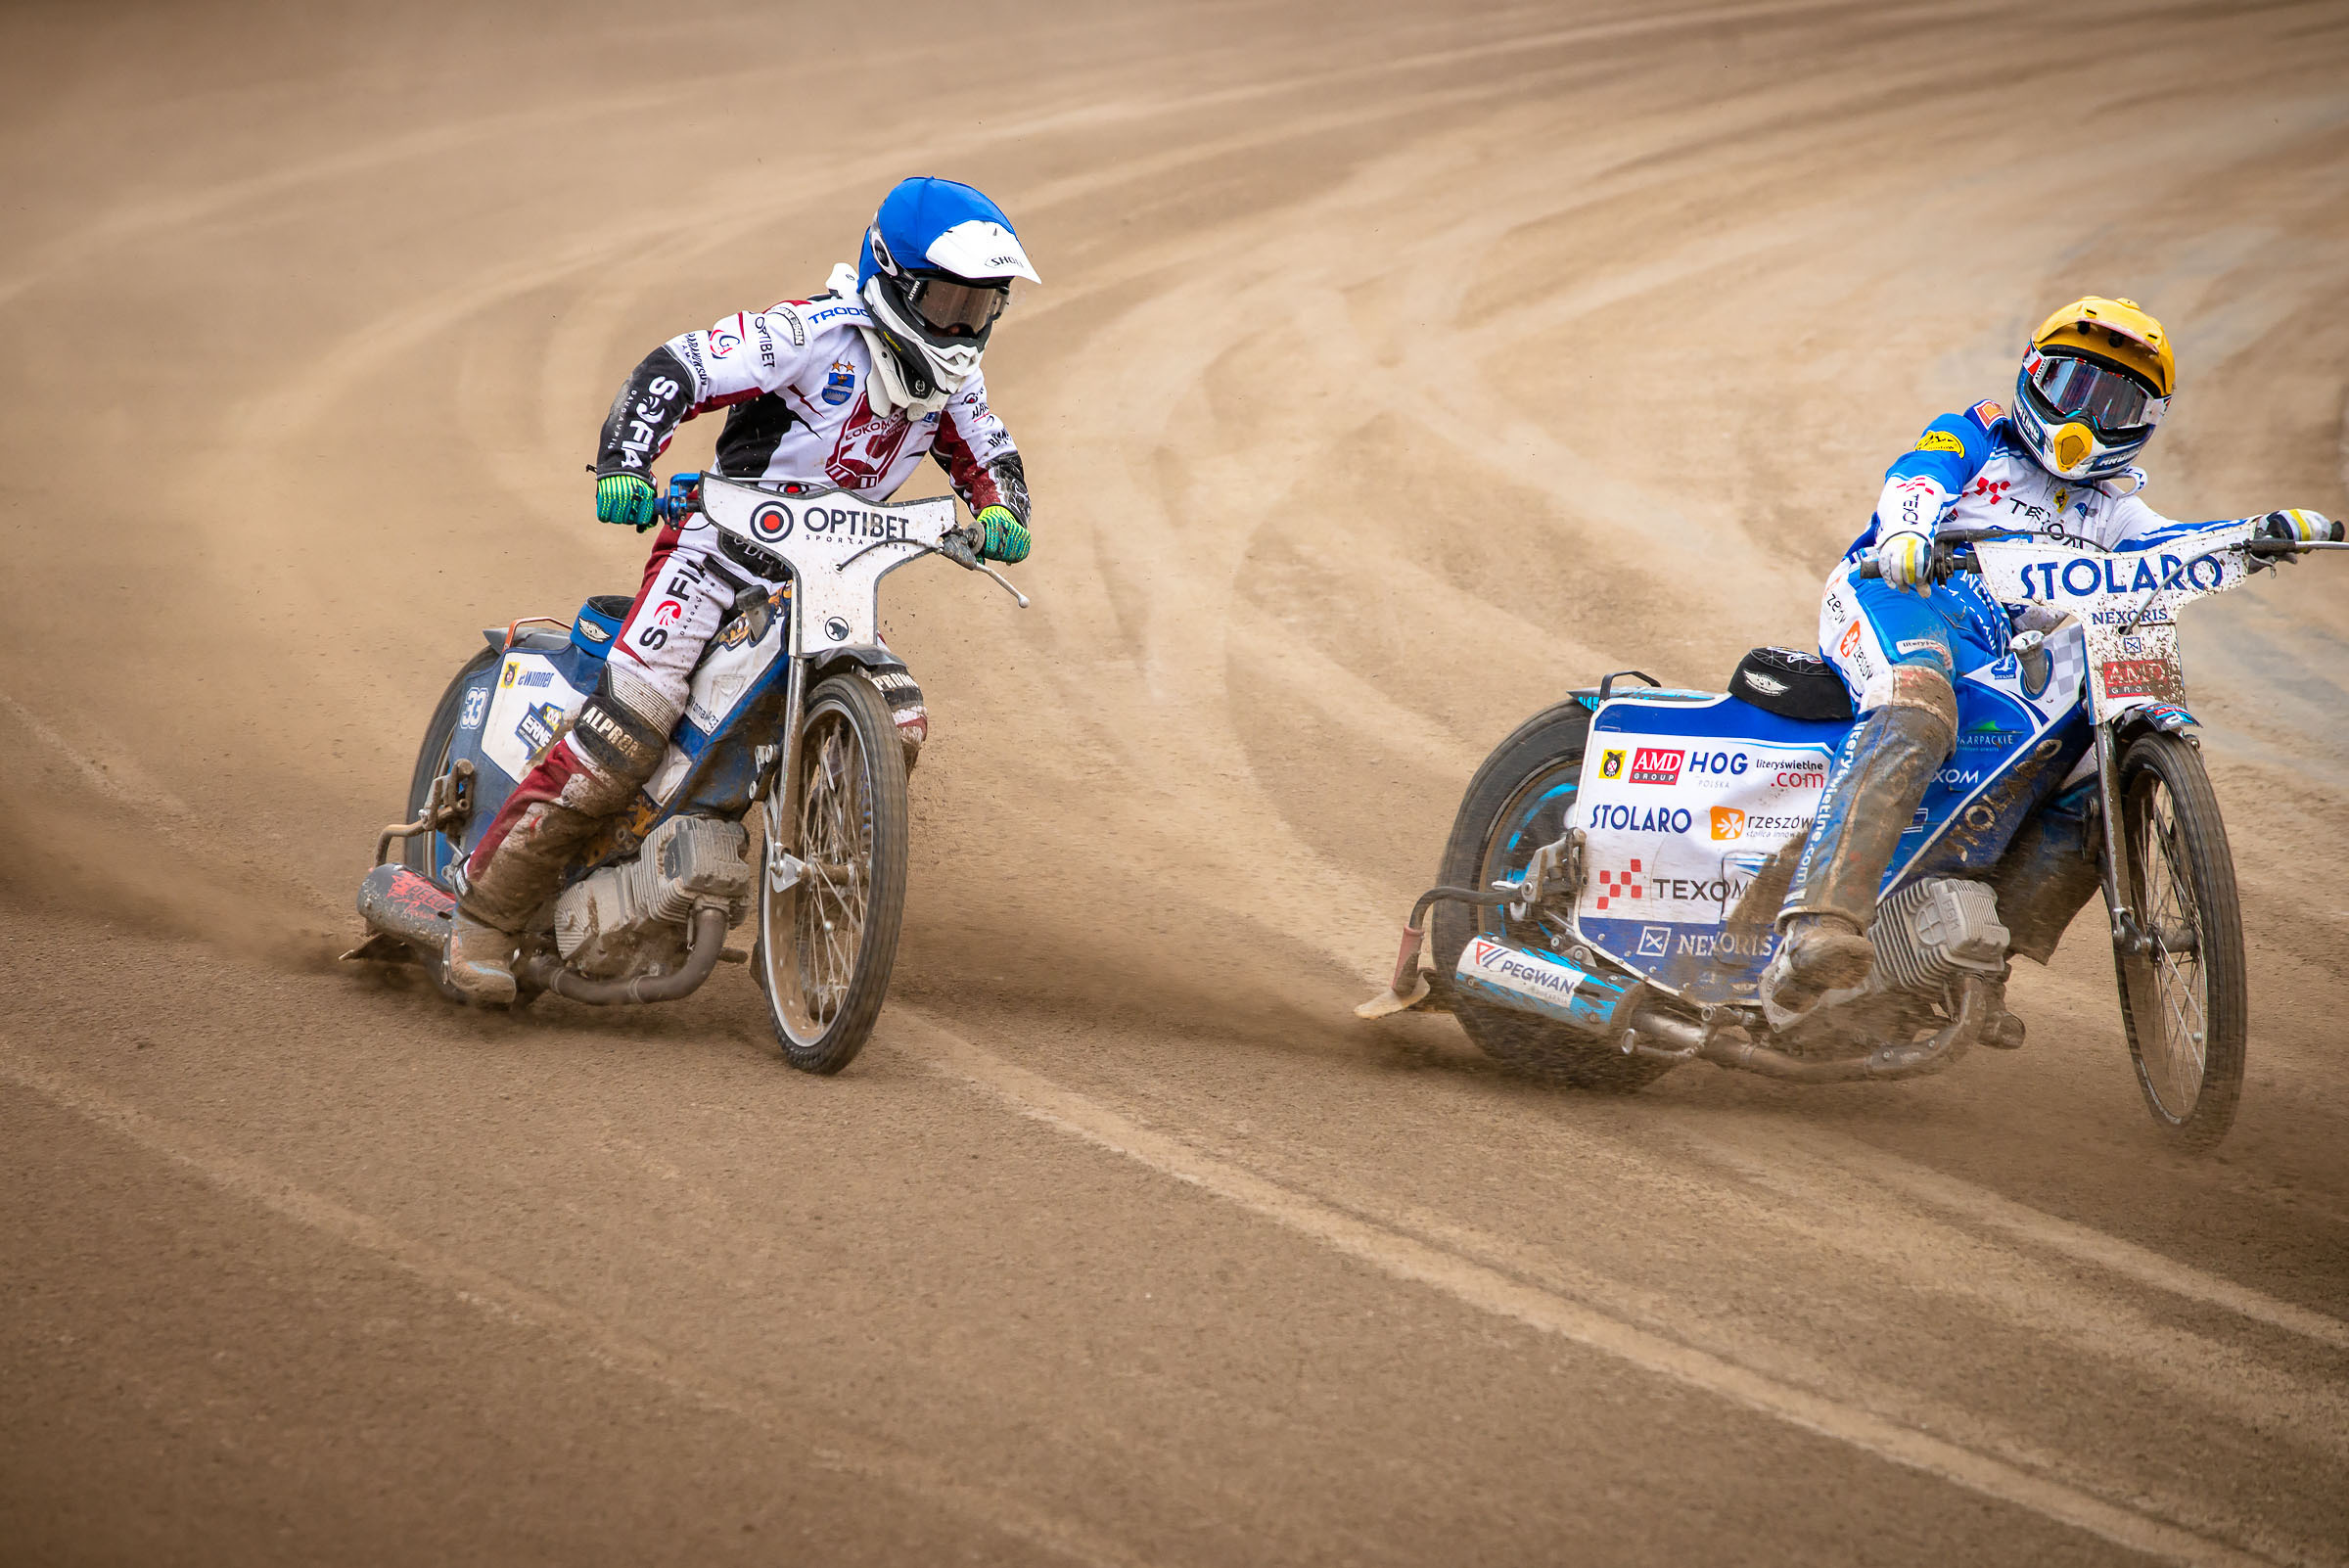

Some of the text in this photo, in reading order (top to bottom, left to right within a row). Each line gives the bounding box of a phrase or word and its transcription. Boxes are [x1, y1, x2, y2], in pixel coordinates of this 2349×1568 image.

[755, 316, 775, 368] OPTIBET
[804, 506, 909, 540] OPTIBET
[806, 534, 863, 545] SPORTA
[2020, 554, 2223, 600] STOLARO
[2092, 608, 2167, 625] NEXORIS
[518, 670, 555, 688] eWinner
[460, 687, 489, 729] 33
[1634, 751, 1683, 771] AMD
[1688, 751, 1748, 775] HOG
[1634, 772, 1676, 782] GROUP
[1771, 771, 1824, 789] .com
[1932, 768, 1979, 784] XOM
[1590, 805, 1692, 833] STOLARO
[1748, 811, 1815, 830] rzeszów
[1652, 878, 1749, 901] TEXOM
[1677, 931, 1773, 957] NEXORIS
[1500, 960, 1575, 995] PEGWAN
